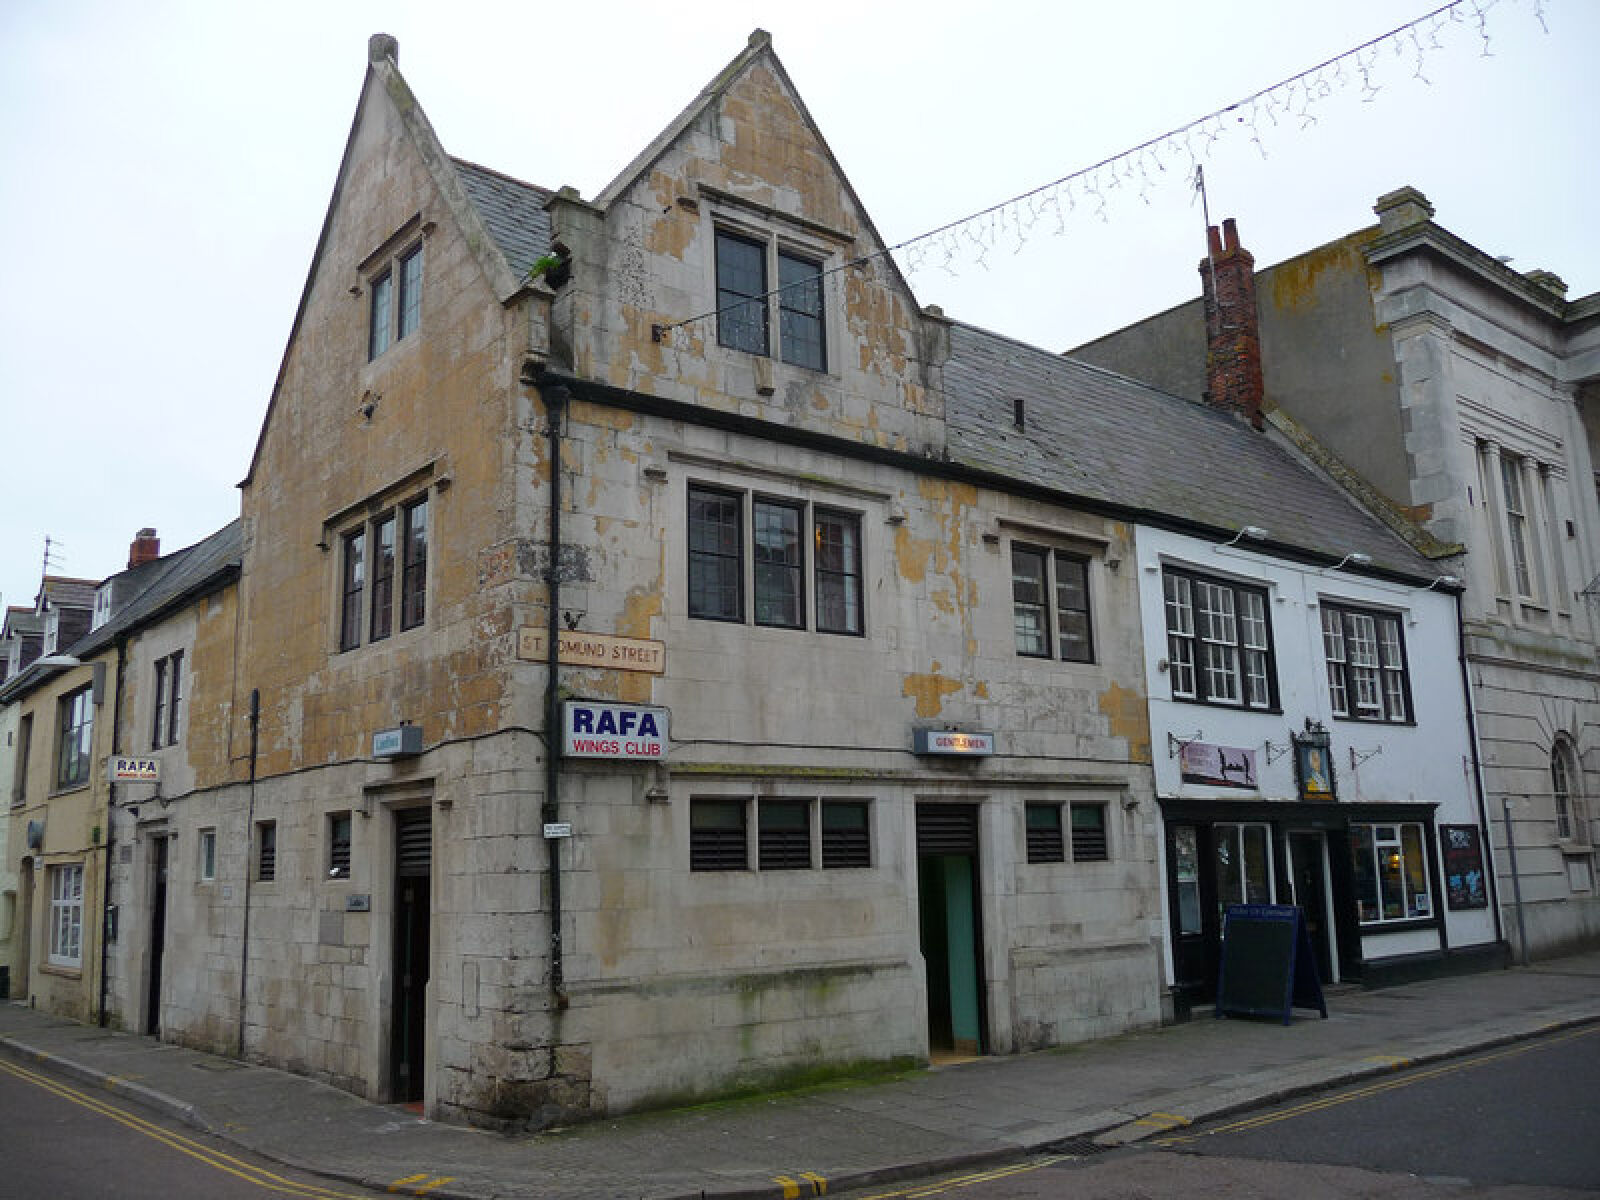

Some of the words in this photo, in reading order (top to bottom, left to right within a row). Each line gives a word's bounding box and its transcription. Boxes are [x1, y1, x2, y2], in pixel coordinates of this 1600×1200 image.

[557, 639, 605, 656] DMUND
[612, 645, 659, 663] STREET
[573, 708, 659, 736] RAFA
[573, 739, 619, 754] WINGS
[625, 741, 661, 755] CLUB
[936, 737, 986, 749] GENTLEMEN
[118, 760, 156, 772] RAFA
